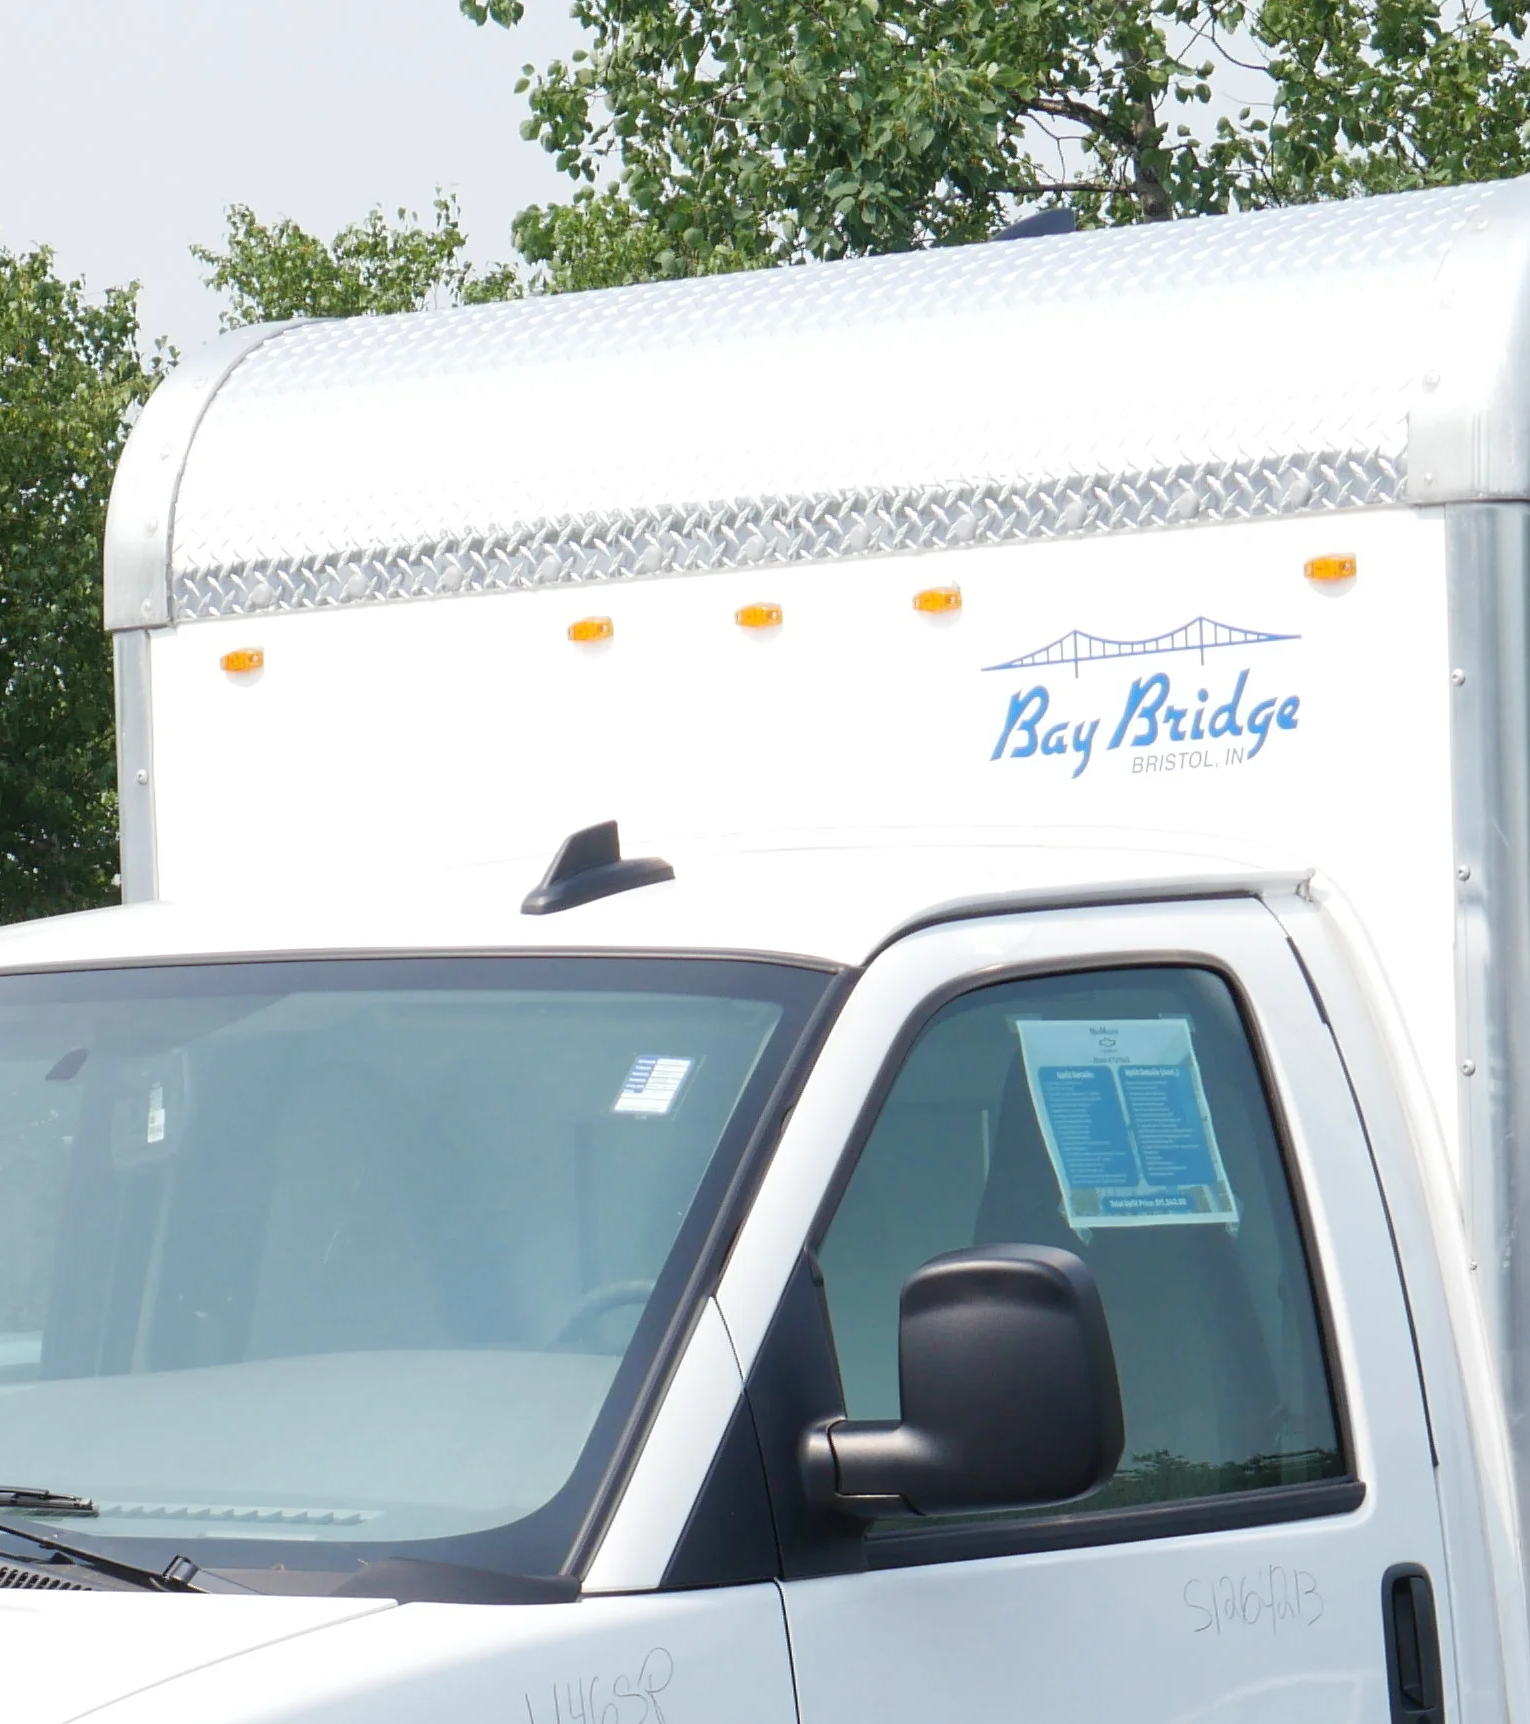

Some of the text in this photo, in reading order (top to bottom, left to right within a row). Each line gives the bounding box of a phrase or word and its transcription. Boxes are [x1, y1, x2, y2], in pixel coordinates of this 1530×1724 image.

[989, 667, 1300, 779] Bay Bridge
[1131, 747, 1245, 774] BRISTOL, IN
